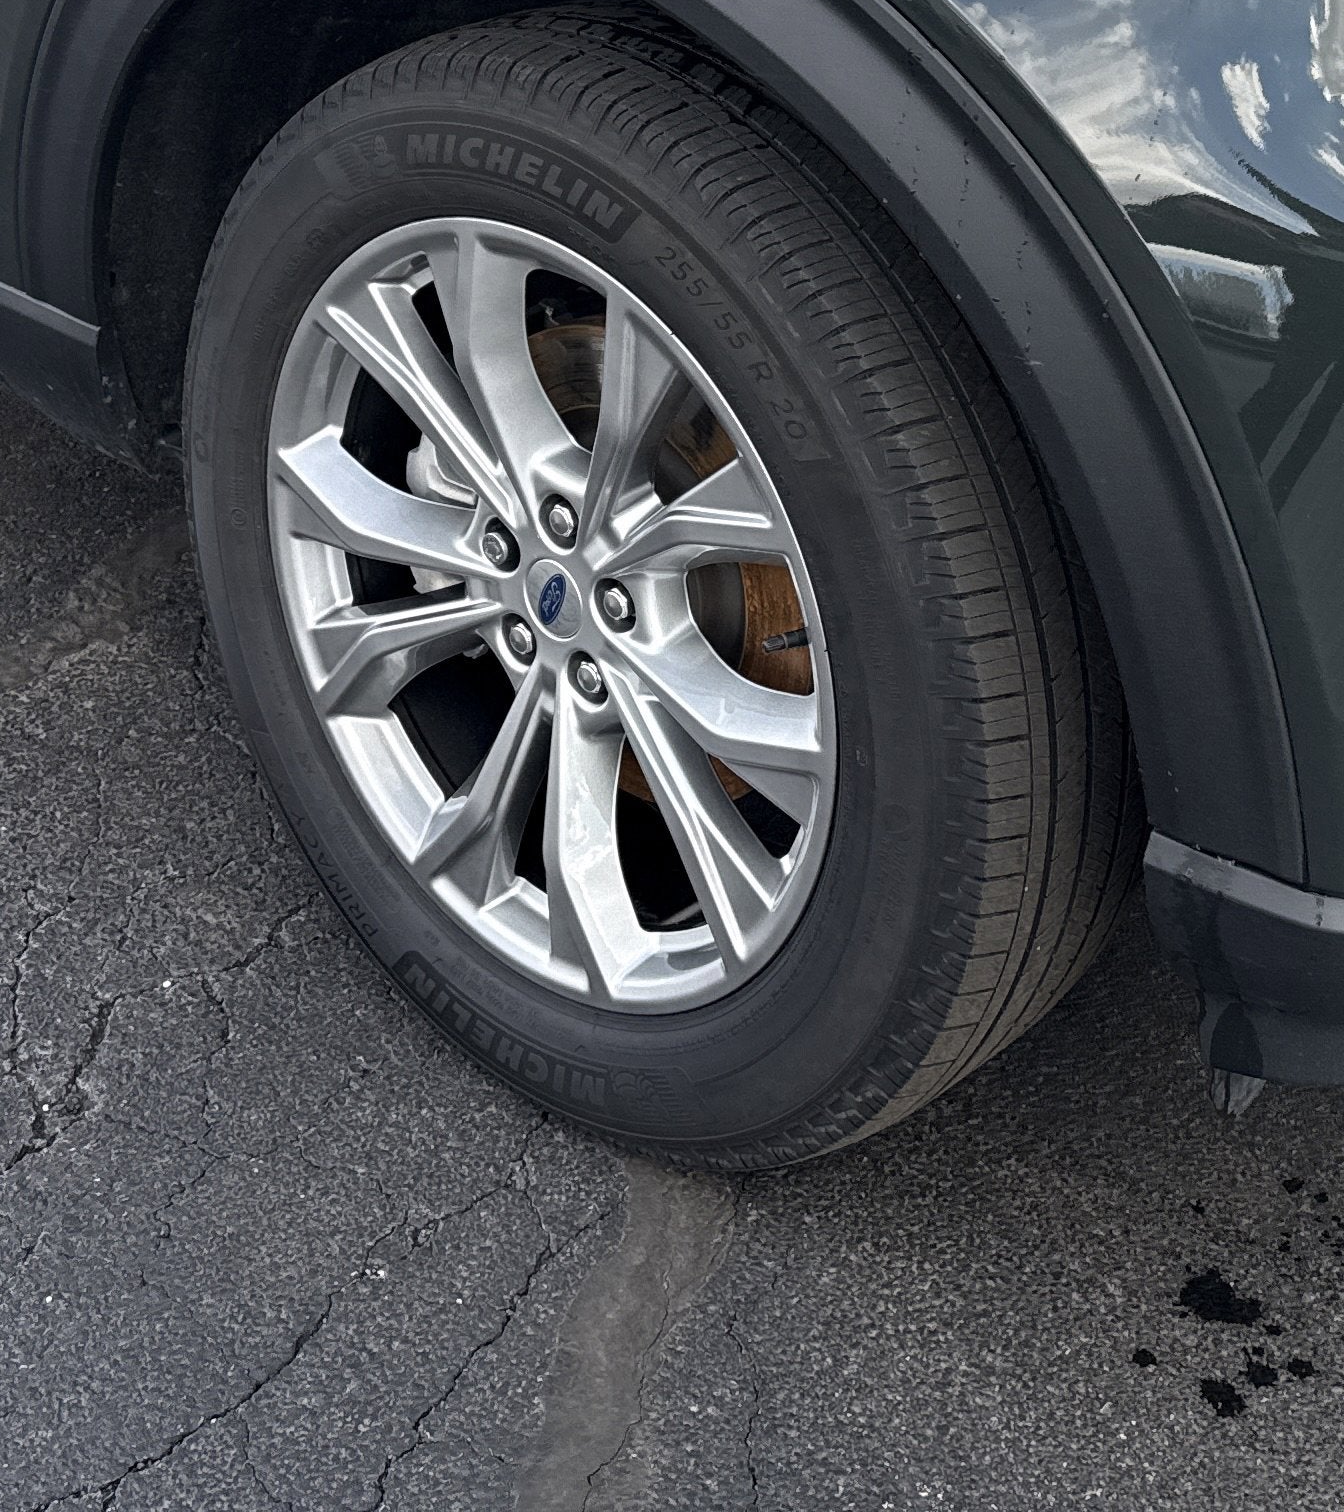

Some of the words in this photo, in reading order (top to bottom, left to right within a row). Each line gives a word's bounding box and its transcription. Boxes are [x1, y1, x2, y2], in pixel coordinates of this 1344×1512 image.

[406, 133, 624, 230] MICHELIN
[654, 245, 753, 351] 255/55
[746, 360, 774, 384] R
[770, 397, 808, 441] 20
[290, 812, 379, 939] PRIMACY
[403, 963, 606, 1106] MICHELIN
